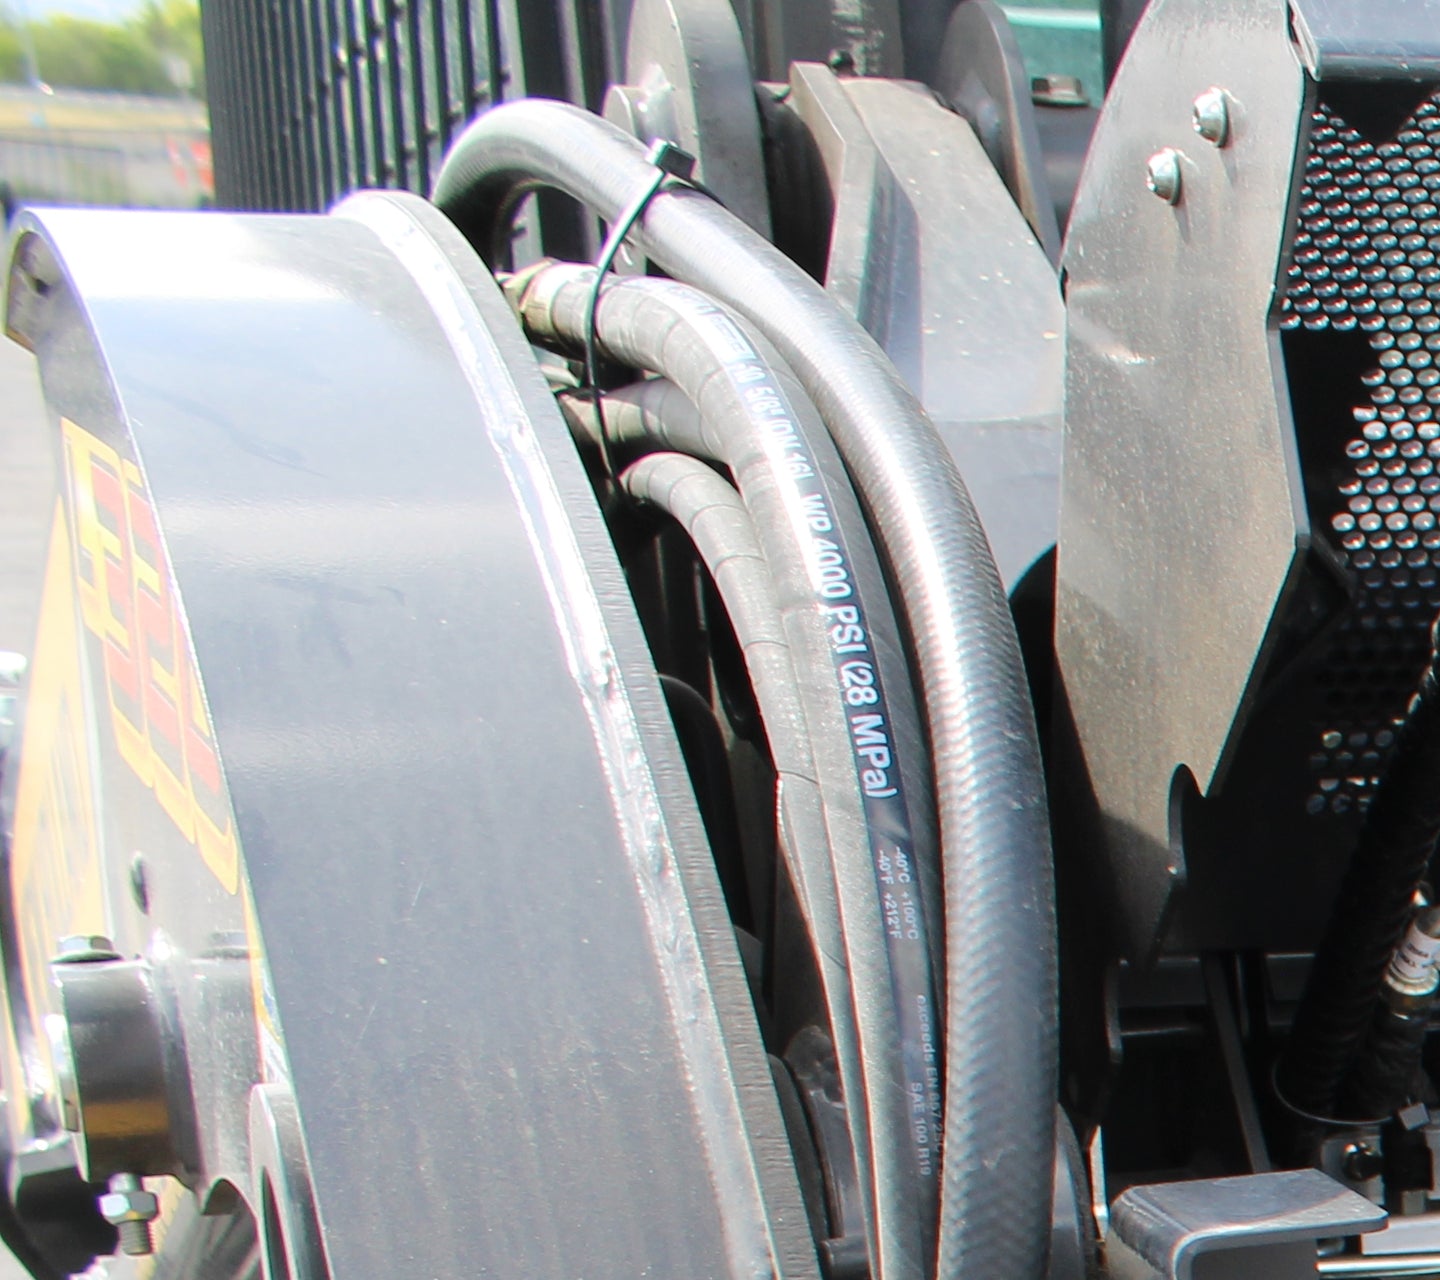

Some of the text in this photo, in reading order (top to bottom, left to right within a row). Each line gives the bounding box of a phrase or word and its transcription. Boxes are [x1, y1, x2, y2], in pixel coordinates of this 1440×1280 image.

[802, 493, 833, 532] WP
[812, 537, 852, 599] 4000
[827, 605, 867, 654] PSI
[840, 661, 878, 706] (28
[852, 715, 898, 798] MPa)
[916, 995, 936, 1062] exceeds
[926, 1067, 938, 1088] EN
[911, 1082, 925, 1112] SAE
[914, 1118, 928, 1144] 100
